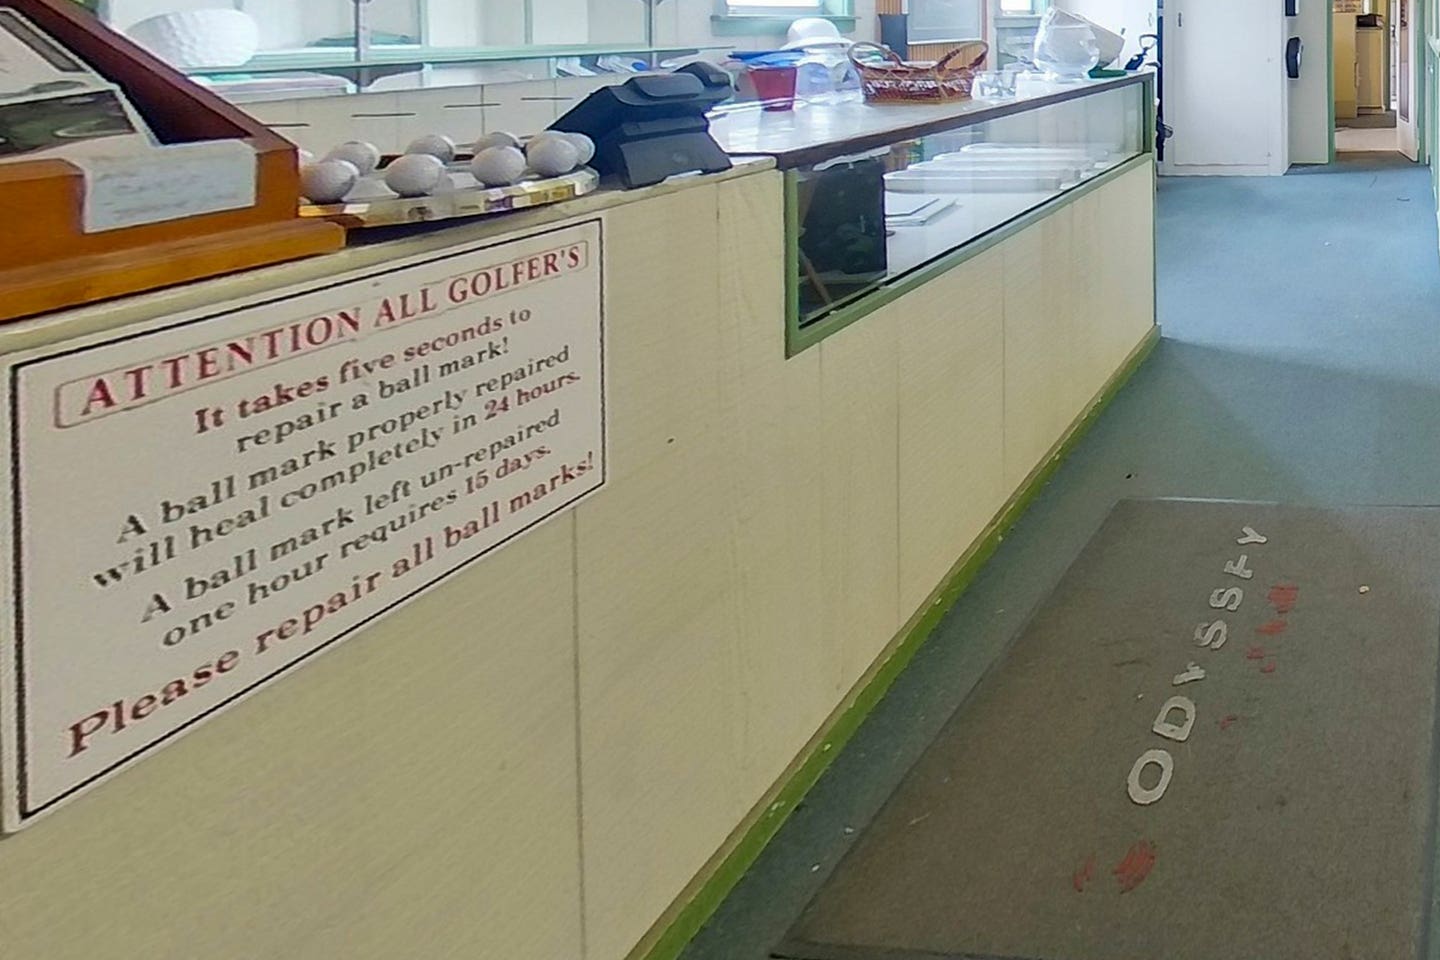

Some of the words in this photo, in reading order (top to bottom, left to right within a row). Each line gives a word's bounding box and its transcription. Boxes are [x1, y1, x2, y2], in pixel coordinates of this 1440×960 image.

[80, 307, 361, 416] ATTENTION
[374, 288, 437, 327] ALL
[449, 246, 580, 303] GOLFER'S
[195, 407, 224, 433] It
[237, 374, 329, 418] takes
[339, 353, 395, 384] five
[403, 315, 503, 362] seconds
[510, 308, 531, 325] to
[236, 401, 342, 453] repair
[352, 393, 369, 410] a
[378, 365, 430, 399] ball
[439, 336, 509, 377] mark!
[93, 536, 176, 587] will
[189, 496, 270, 549] heal
[280, 427, 444, 509] completely
[453, 414, 477, 435] in
[484, 395, 509, 421] 24
[517, 371, 581, 406] hours.
[117, 514, 147, 544] A
[160, 476, 235, 523] ball
[248, 439, 336, 490] mark
[347, 391, 467, 454] properly
[475, 345, 570, 397] repaired
[140, 593, 171, 623] A
[184, 549, 257, 600] ball
[270, 507, 354, 562] mark
[364, 480, 411, 515] left
[420, 408, 560, 489] un-repaired
[163, 601, 235, 646] one
[248, 552, 329, 605] hour
[340, 489, 458, 559] requires
[465, 470, 489, 494] 15
[495, 443, 551, 479] days.
[67, 650, 239, 759] Please
[255, 570, 381, 655] repair
[391, 537, 433, 578] all
[444, 501, 500, 548] ball
[509, 451, 594, 514] marks!
